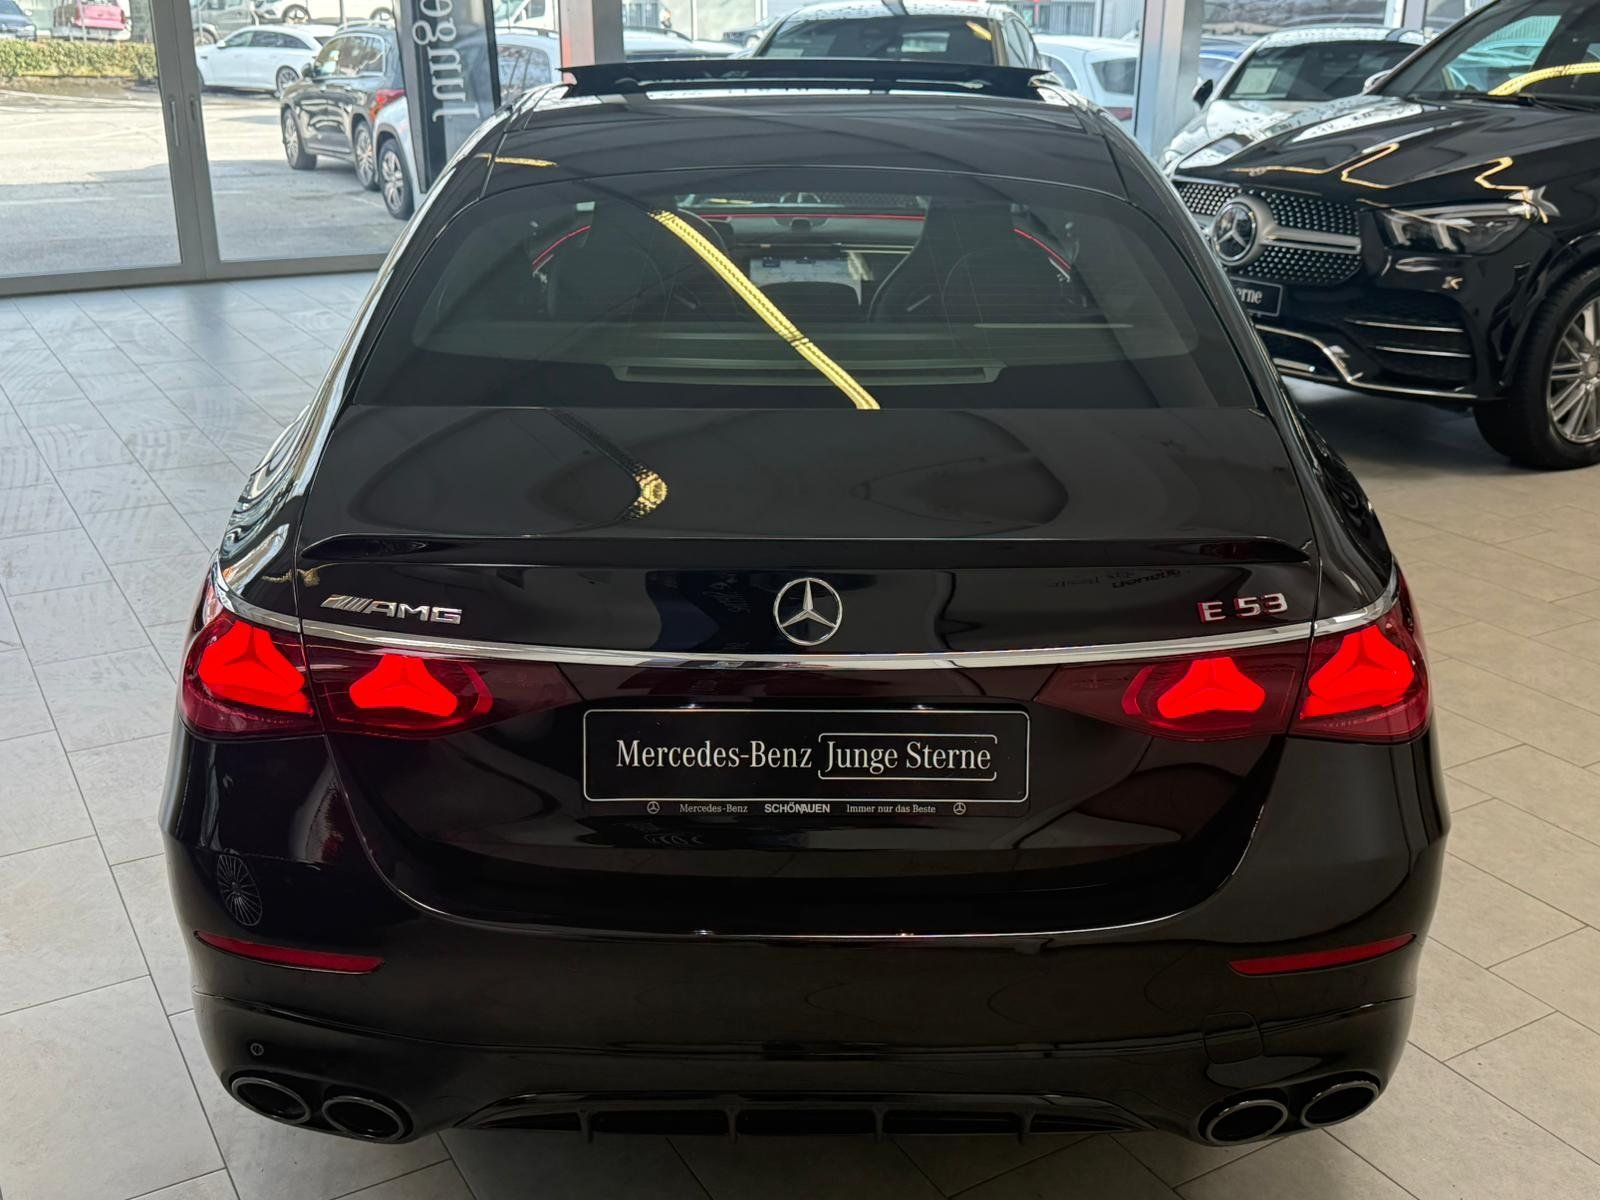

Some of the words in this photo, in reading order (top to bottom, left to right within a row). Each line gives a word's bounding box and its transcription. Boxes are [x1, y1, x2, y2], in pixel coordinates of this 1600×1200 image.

[1197, 601, 1226, 624] E
[1234, 592, 1289, 617] 53
[616, 739, 812, 768] Mercedes-Benz
[825, 741, 898, 775] Junge
[905, 741, 992, 770] Sterne
[679, 803, 748, 813] Mercedes-Benz
[764, 802, 831, 814] SCHÖNAUEN
[846, 803, 876, 813] Immer
[877, 804, 894, 813] nur
[894, 803, 911, 813] das
[912, 803, 937, 813] Beste
